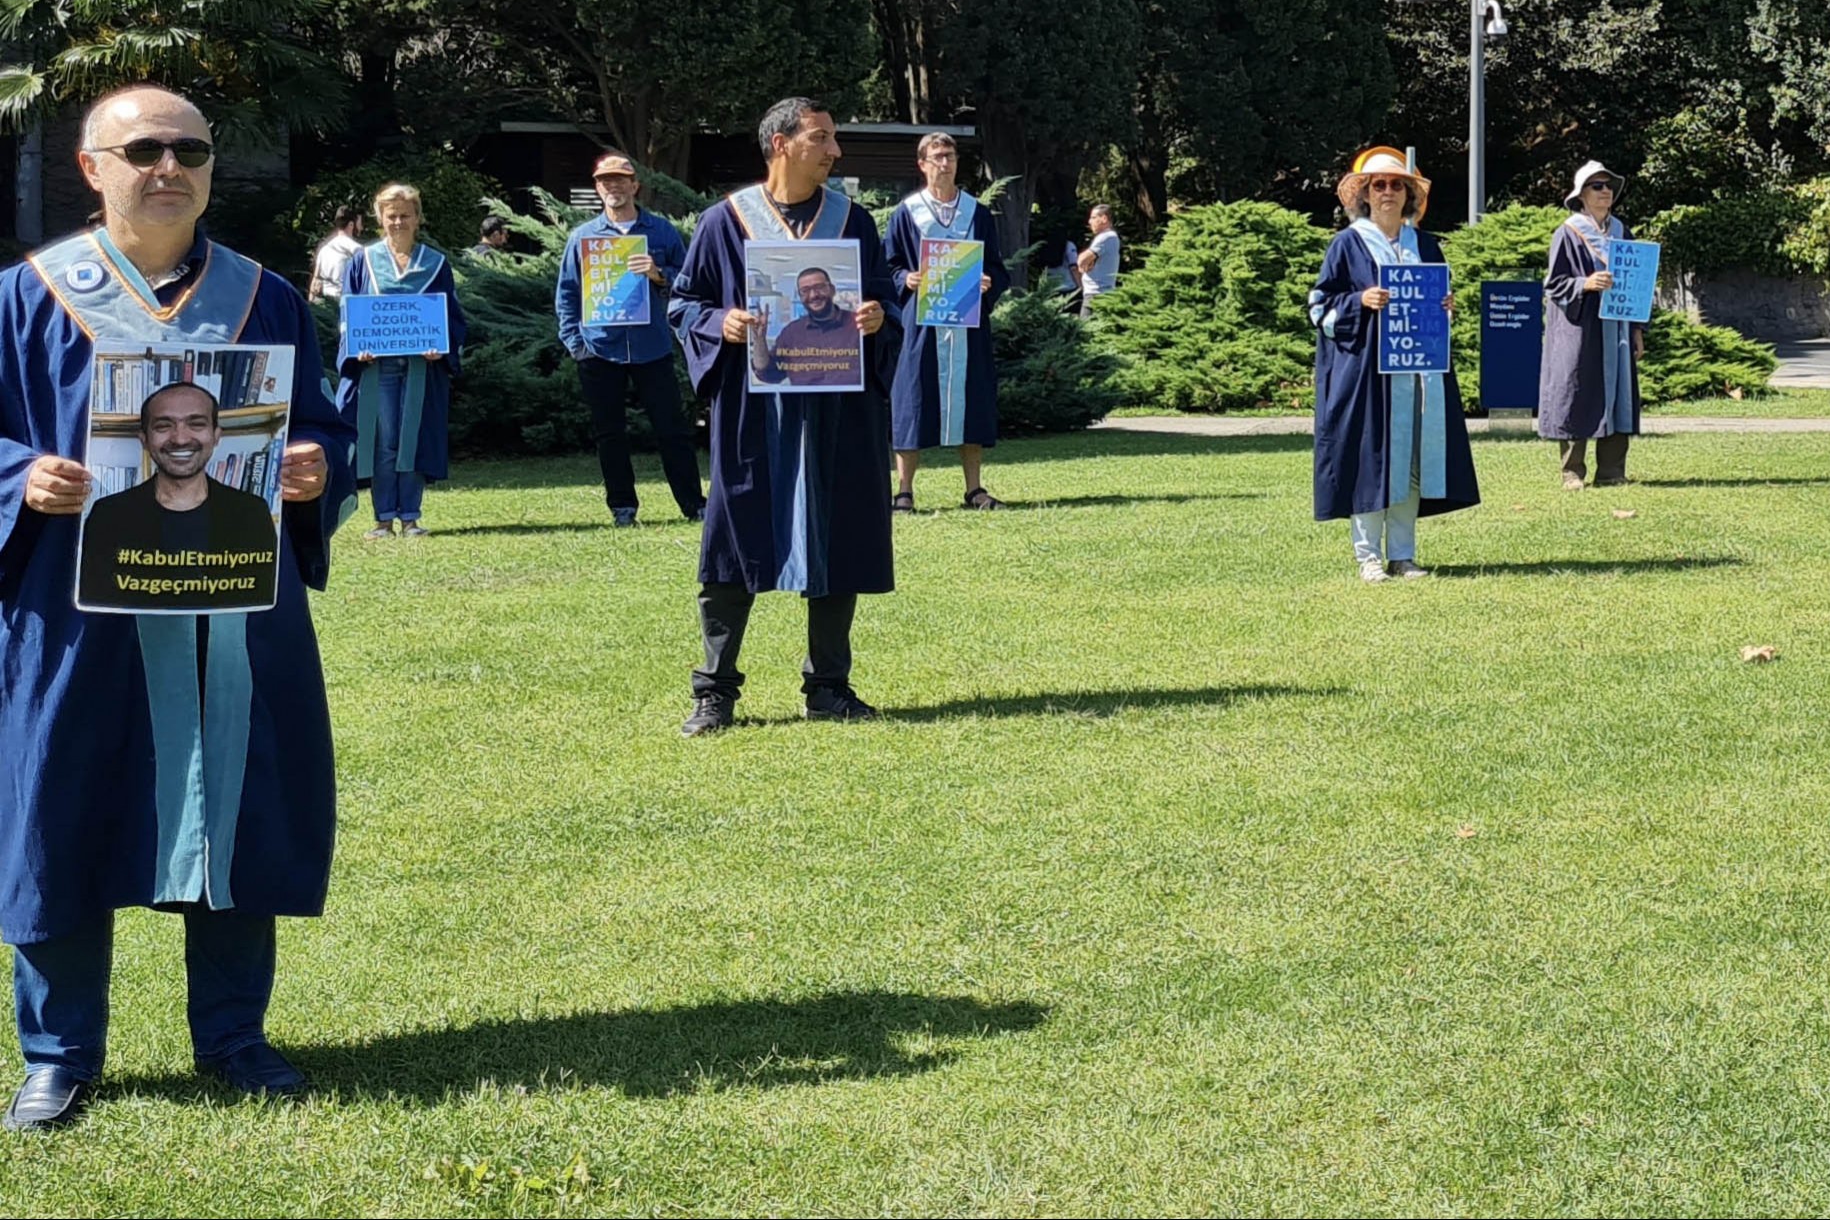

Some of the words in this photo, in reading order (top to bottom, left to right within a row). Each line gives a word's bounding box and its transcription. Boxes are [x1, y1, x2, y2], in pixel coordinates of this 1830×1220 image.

[588, 240, 621, 251] KA-
[928, 243, 959, 254] KA-
[1616, 244, 1640, 255] KA-
[590, 253, 624, 266] BUL
[928, 256, 960, 269] BUL
[1615, 256, 1640, 268] BUL
[591, 267, 618, 279] ET-
[1388, 269, 1422, 282] KA-
[1388, 285, 1425, 299] BUL
[371, 300, 422, 312] ÖZERK,
[591, 296, 623, 307] YO-
[591, 308, 633, 321] RUZ.
[925, 309, 965, 322] RUZ.
[1388, 302, 1418, 316] ET-
[1607, 304, 1638, 317] RUZ.
[352, 323, 441, 338] DEMOKRATİK
[1388, 315, 1418, 333] Mİ-
[357, 337, 438, 351] ÜNİVERSİTE
[1388, 336, 1422, 350] YO-
[776, 347, 859, 358] #KabulEtmiyoruz
[1388, 352, 1432, 367] RUZ.
[776, 361, 850, 372] Vazgeçmiyoruz
[117, 549, 274, 568] #KabulEtmiyoruz
[116, 574, 256, 595] Vazgeçmiyoruz
